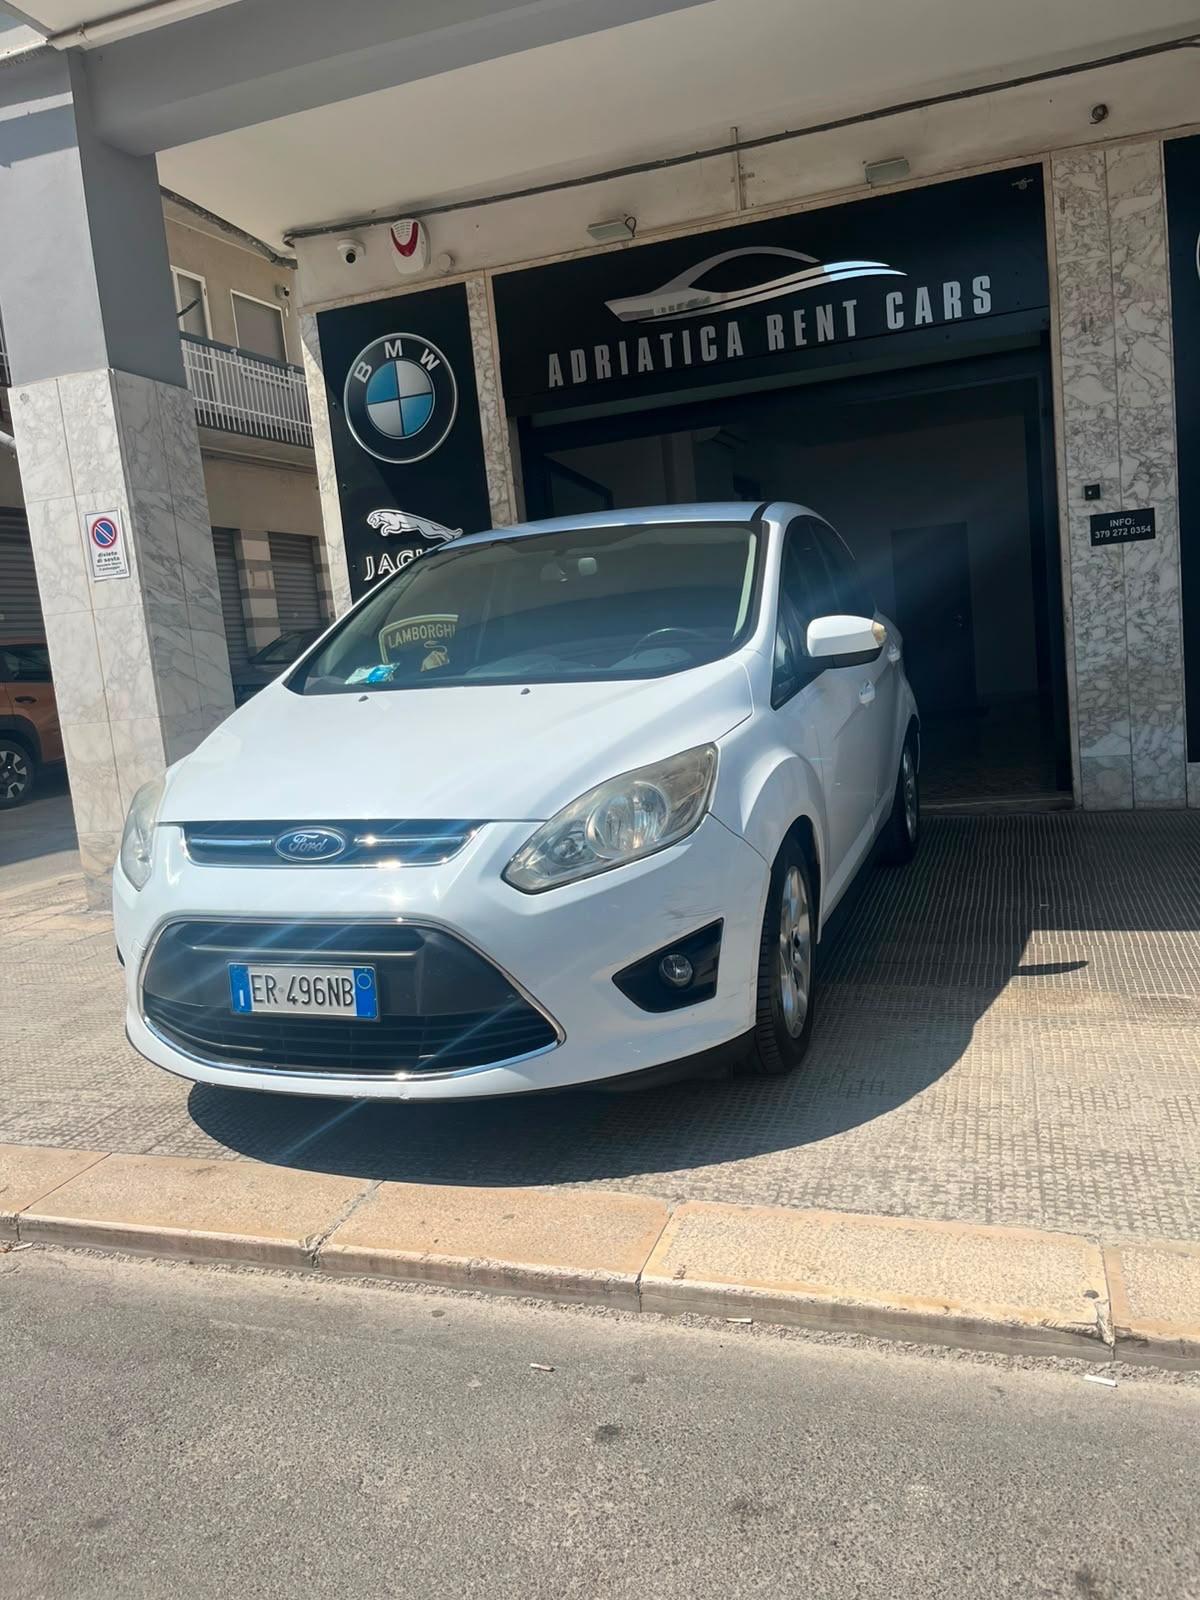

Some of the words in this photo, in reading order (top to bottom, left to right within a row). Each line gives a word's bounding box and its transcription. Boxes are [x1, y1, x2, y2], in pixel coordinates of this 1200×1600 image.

[548, 320, 744, 388] ADRIATICA
[766, 300, 858, 351] RENT
[885, 274, 992, 330] CARS
[353, 339, 441, 384] BMW
[1095, 530, 1110, 539] 379
[1112, 528, 1128, 537] 272
[1130, 525, 1151, 534] 0354
[1110, 518, 1135, 527] INFO:
[288, 833, 329, 852] Ford
[250, 974, 278, 1004] ER
[286, 975, 355, 1007] 496NB
